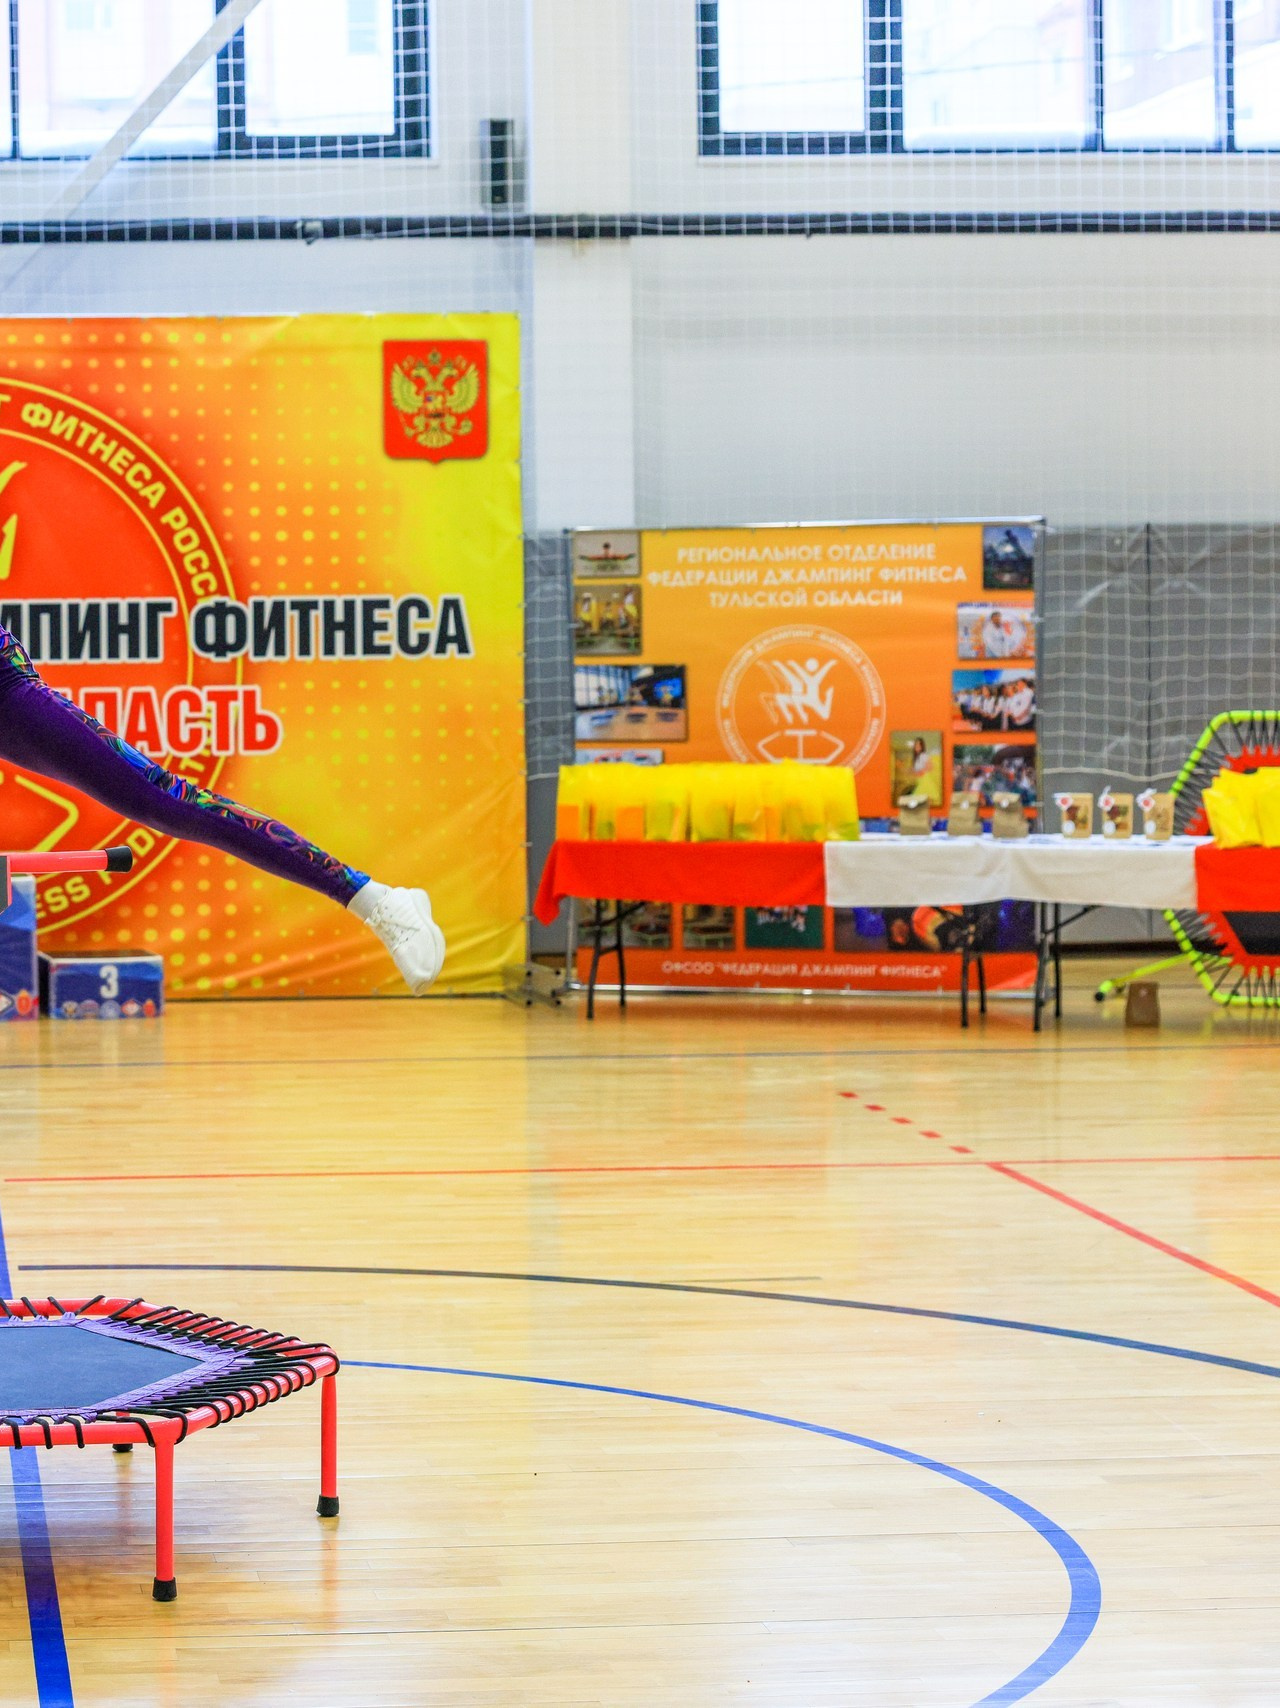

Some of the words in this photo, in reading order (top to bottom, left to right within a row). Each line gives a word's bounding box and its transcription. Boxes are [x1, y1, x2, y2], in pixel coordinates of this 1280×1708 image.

[20, 402, 167, 509] ФИТНЕСА
[160, 505, 220, 603] РОСС
[677, 545, 823, 564] РЕГИОНАЛЬНОЕ
[827, 543, 937, 562] ОТДЕЛЕНИЕ
[647, 569, 758, 588] ФЕДЕРАЦИИ
[763, 567, 874, 586] ДЖАМПИНГ
[878, 564, 968, 583] ФИТНЕСА
[709, 587, 808, 608] ТУЛЬСКОЙ
[812, 588, 904, 608] ОБЛАСТИ
[193, 594, 474, 660] ФИТНЕСА
[99, 964, 120, 999] 3
